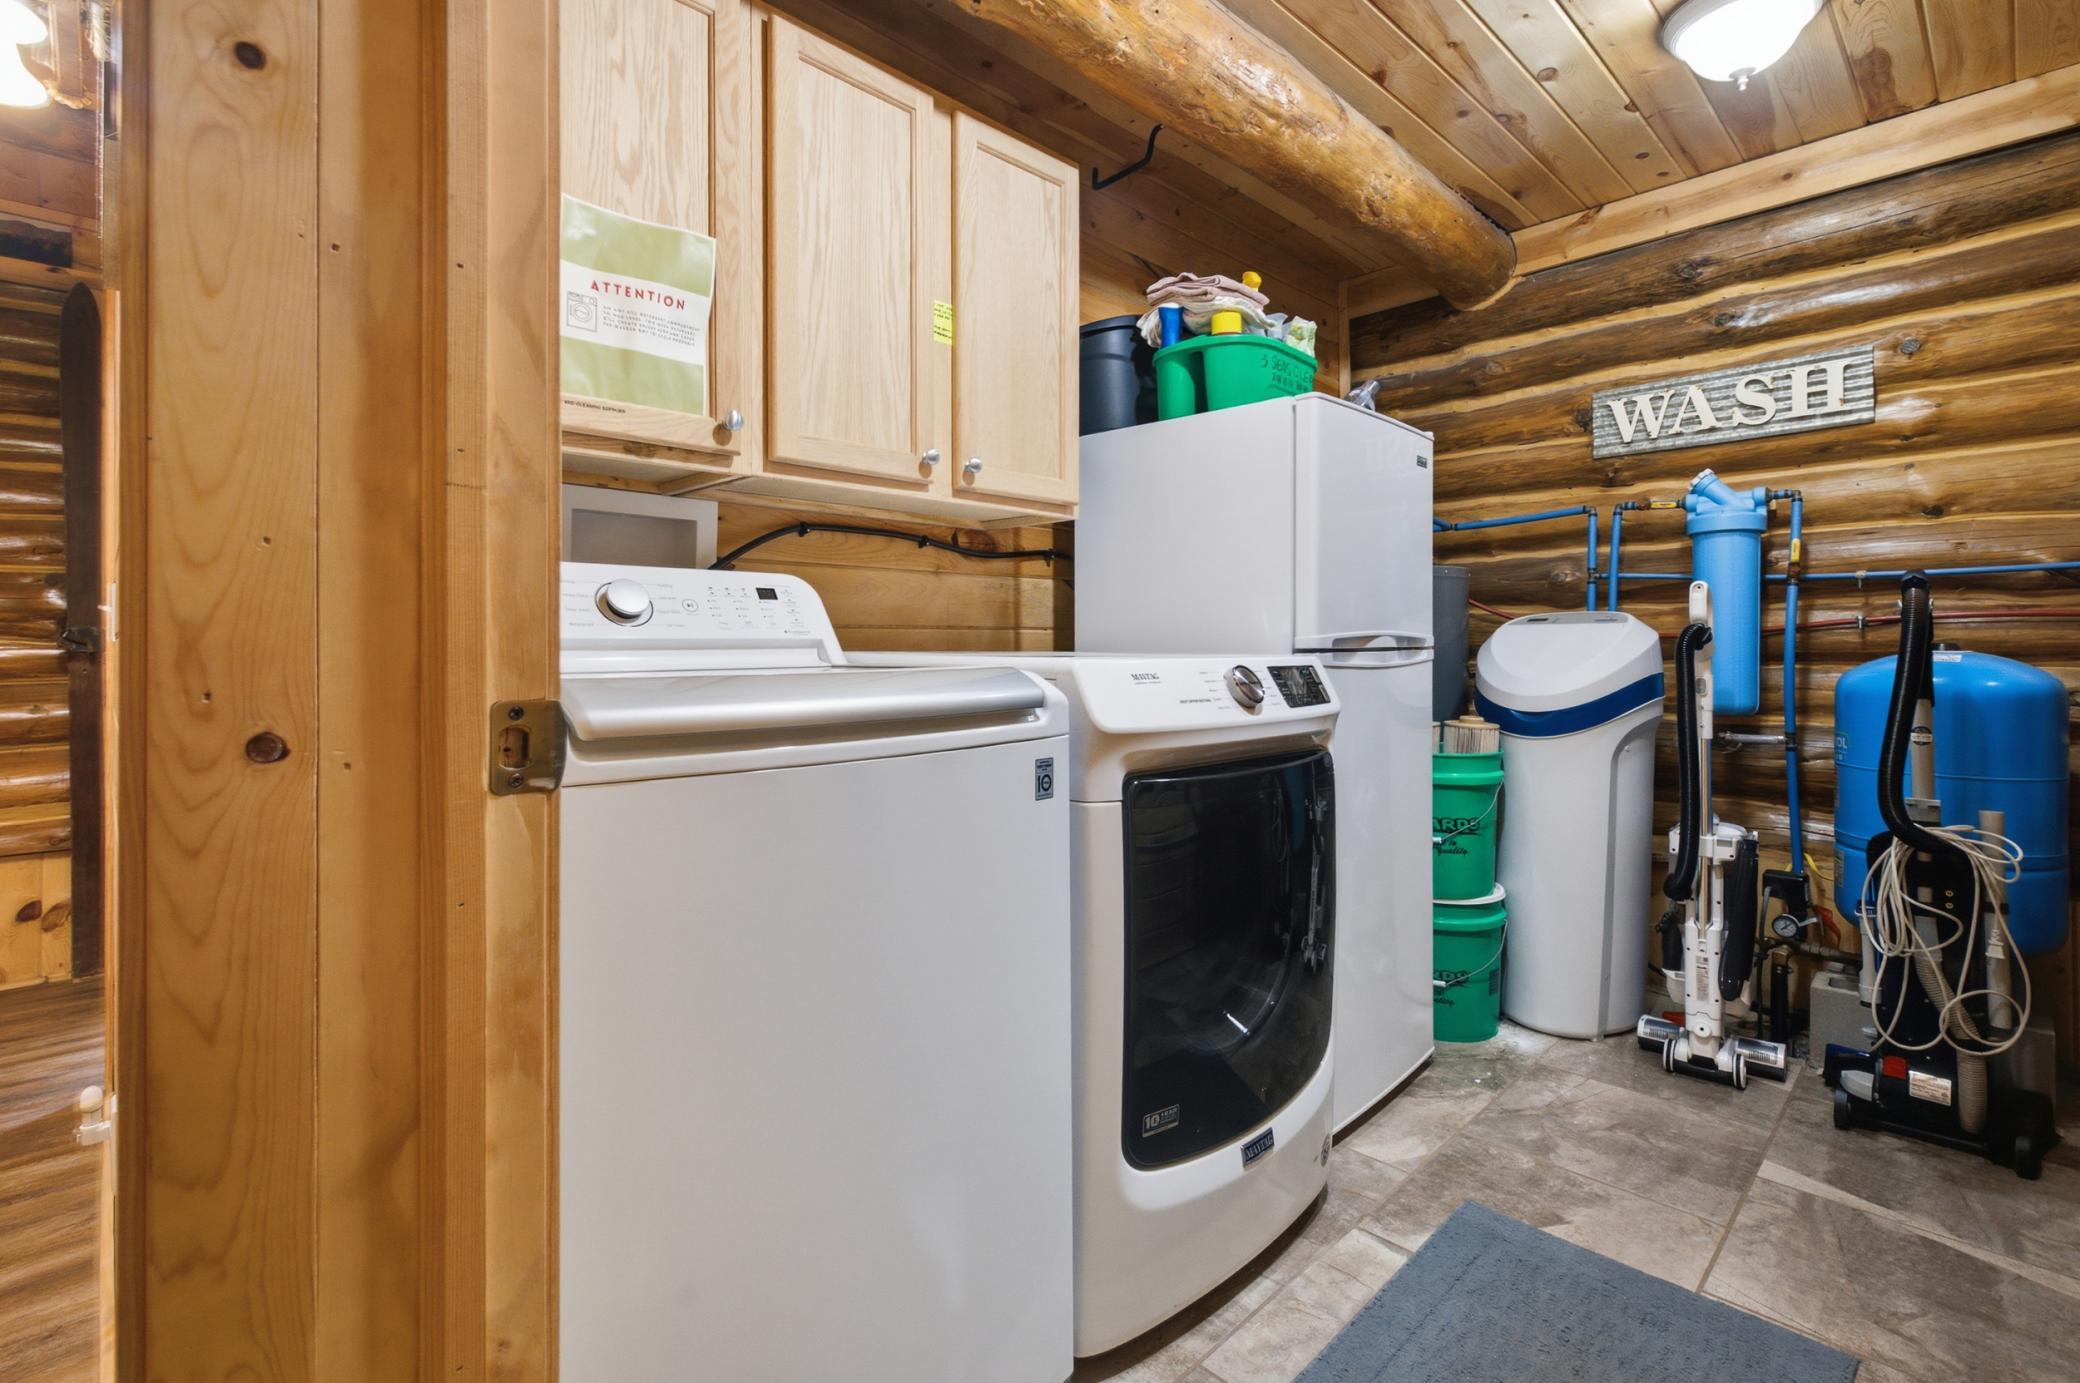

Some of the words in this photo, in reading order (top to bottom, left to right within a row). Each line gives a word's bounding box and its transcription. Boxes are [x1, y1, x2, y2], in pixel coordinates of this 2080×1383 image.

[591, 280, 685, 311] ATTENTION
[1605, 359, 1853, 444] WASH
[1145, 1114, 1161, 1129] 10
